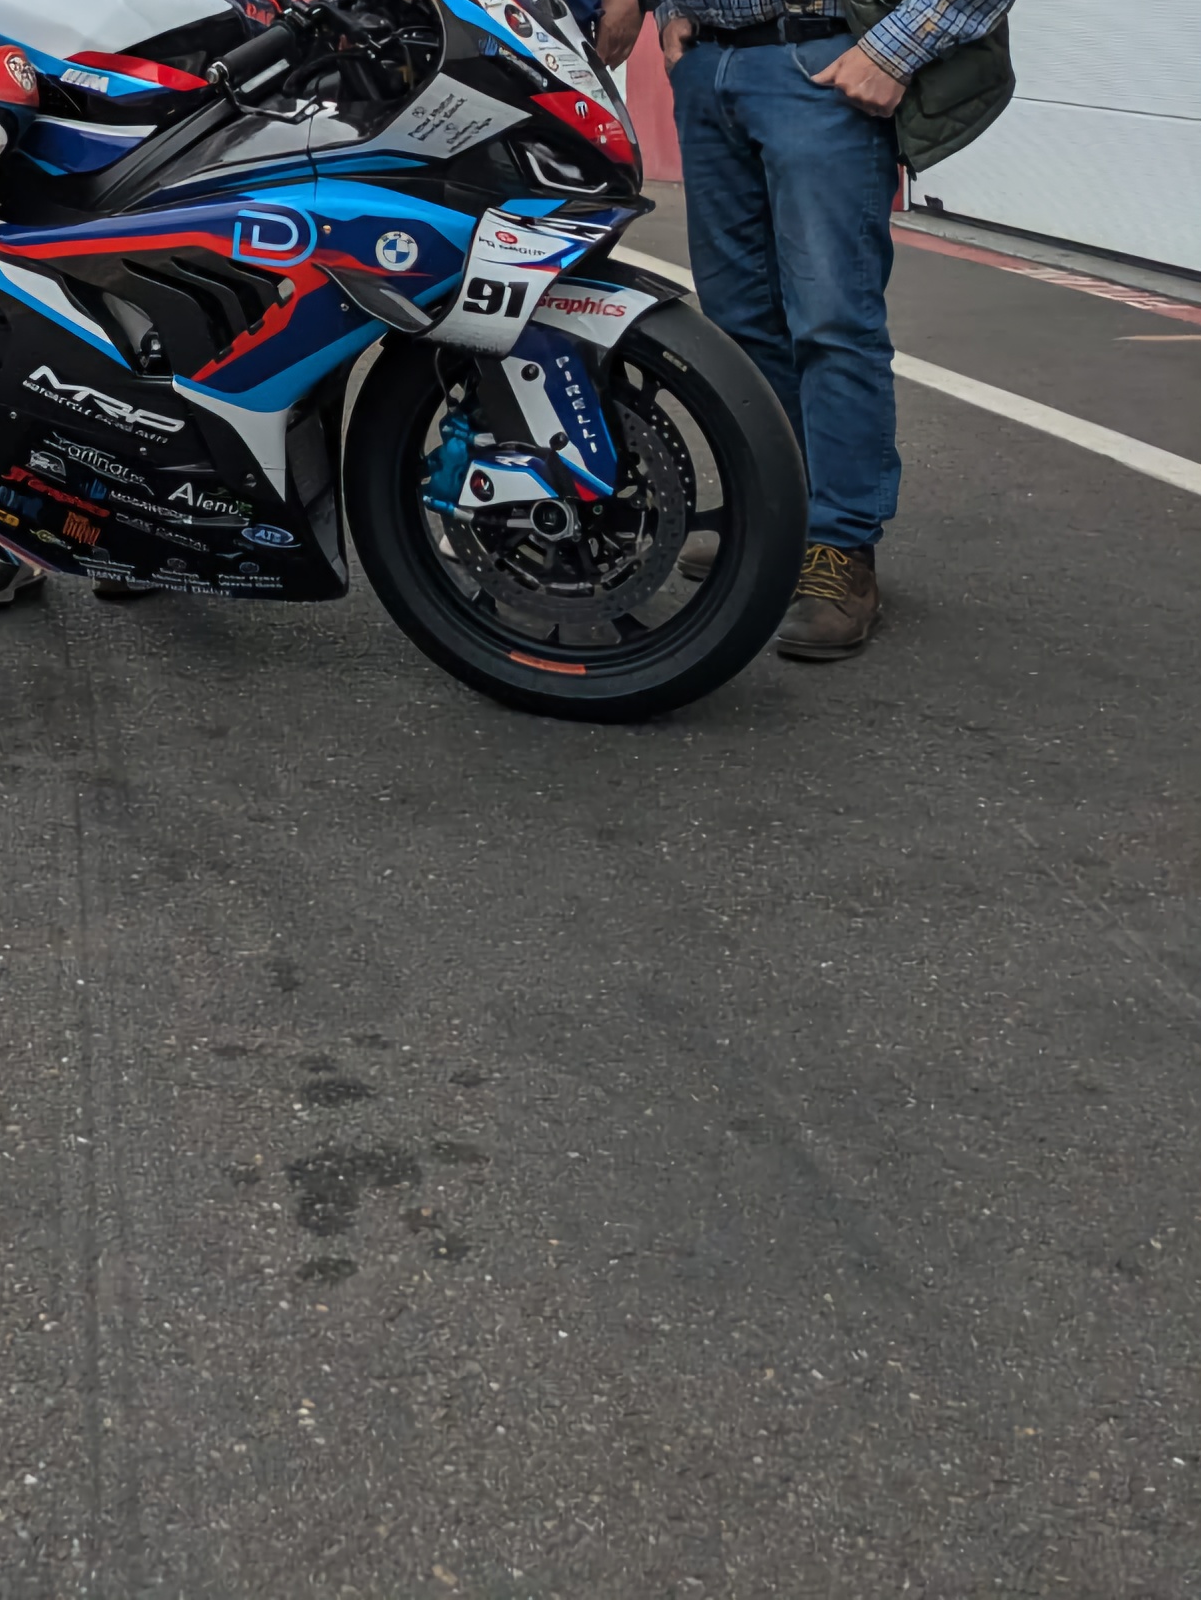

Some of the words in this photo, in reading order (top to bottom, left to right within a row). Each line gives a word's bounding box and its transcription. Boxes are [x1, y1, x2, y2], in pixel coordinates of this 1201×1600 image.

[462, 277, 529, 319] 91
[29, 365, 186, 433] MRP
[556, 356, 597, 454] PIRELLI
